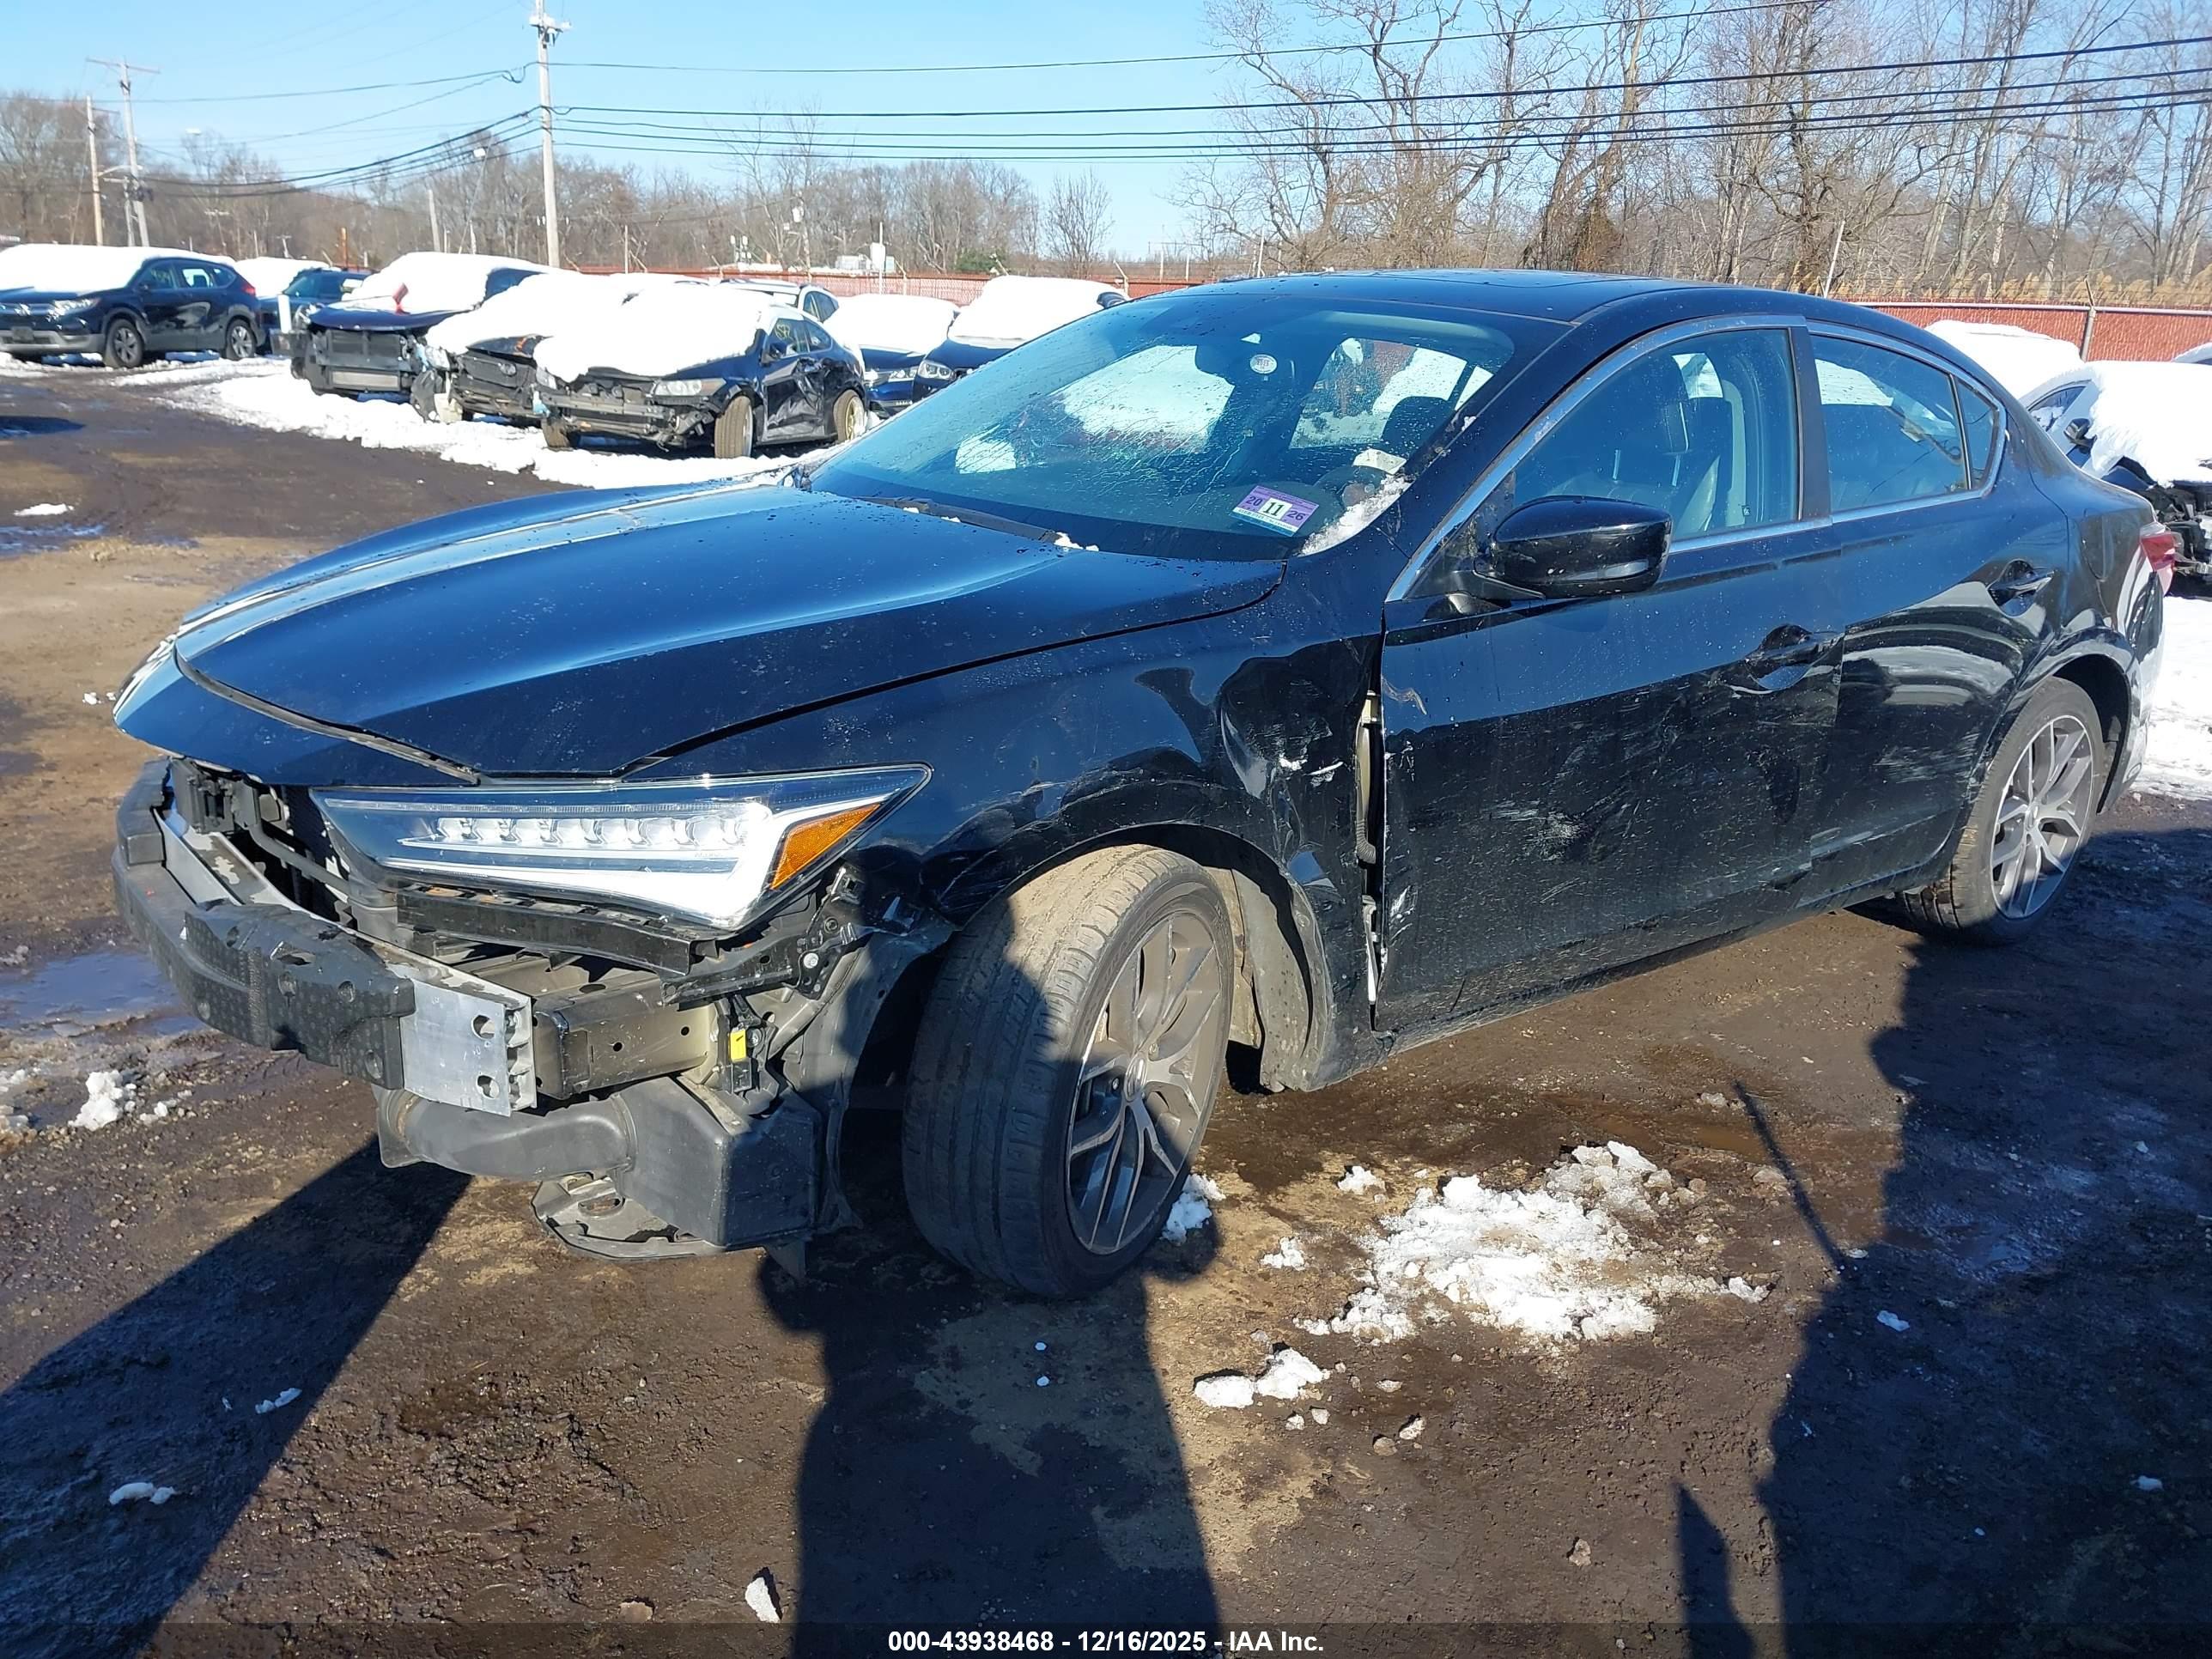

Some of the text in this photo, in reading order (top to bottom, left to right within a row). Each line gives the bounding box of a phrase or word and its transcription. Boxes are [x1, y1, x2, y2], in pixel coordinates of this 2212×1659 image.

[1245, 495, 1263, 507] 20
[1263, 501, 1284, 516] 11
[1286, 510, 1306, 520] 26
